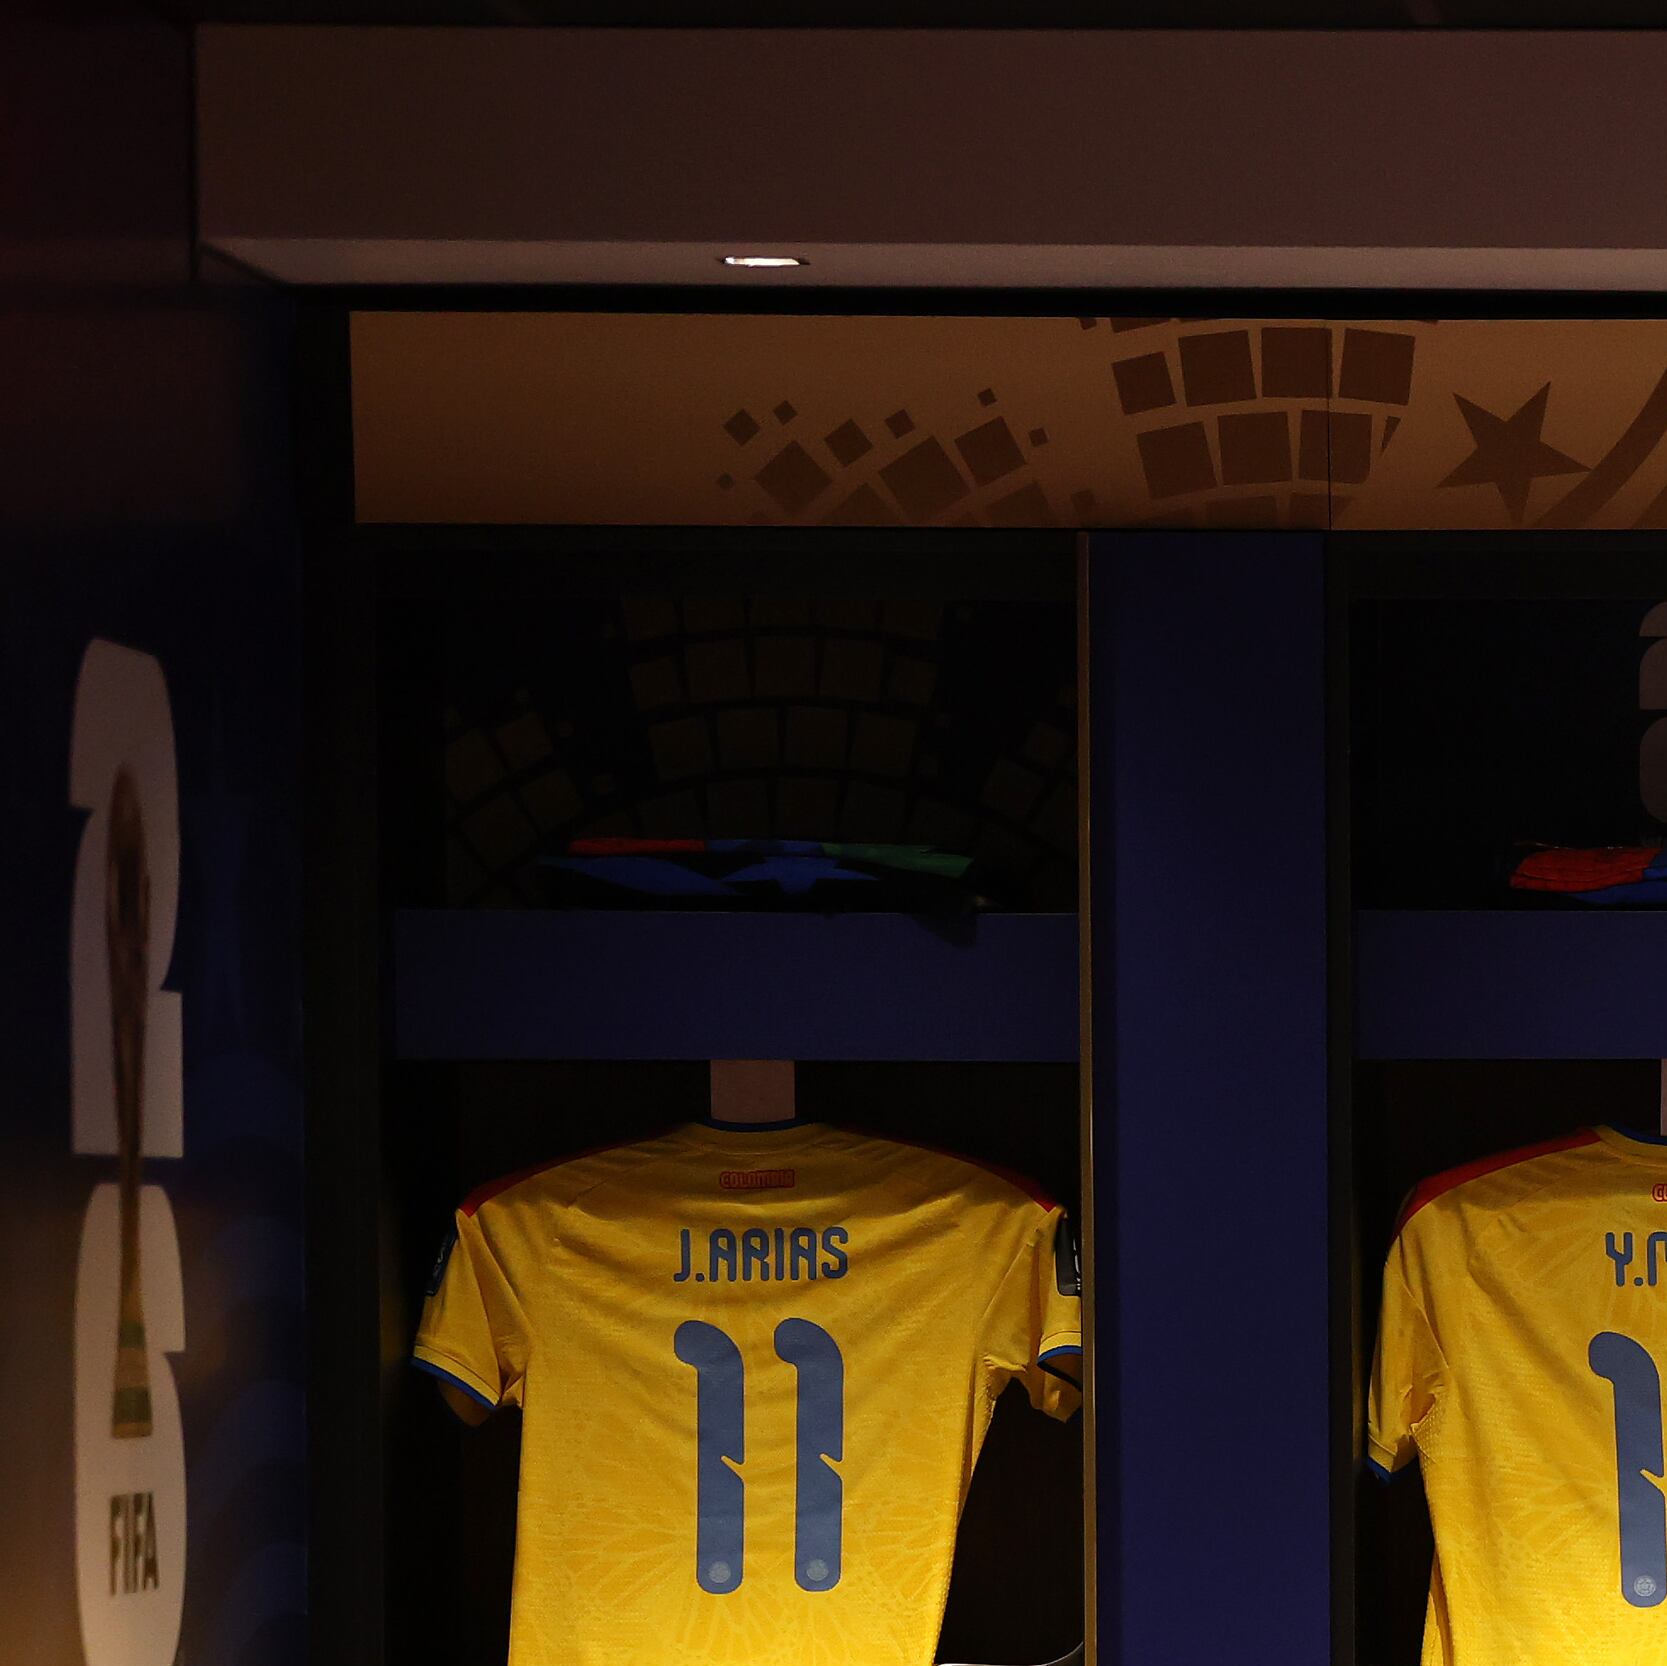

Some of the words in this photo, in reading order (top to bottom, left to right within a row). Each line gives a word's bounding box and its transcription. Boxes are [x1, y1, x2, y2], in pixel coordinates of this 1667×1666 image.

[673, 1226, 849, 1283] J.ARIAS
[674, 1317, 844, 1595] 11
[109, 1491, 159, 1597] FIFA
